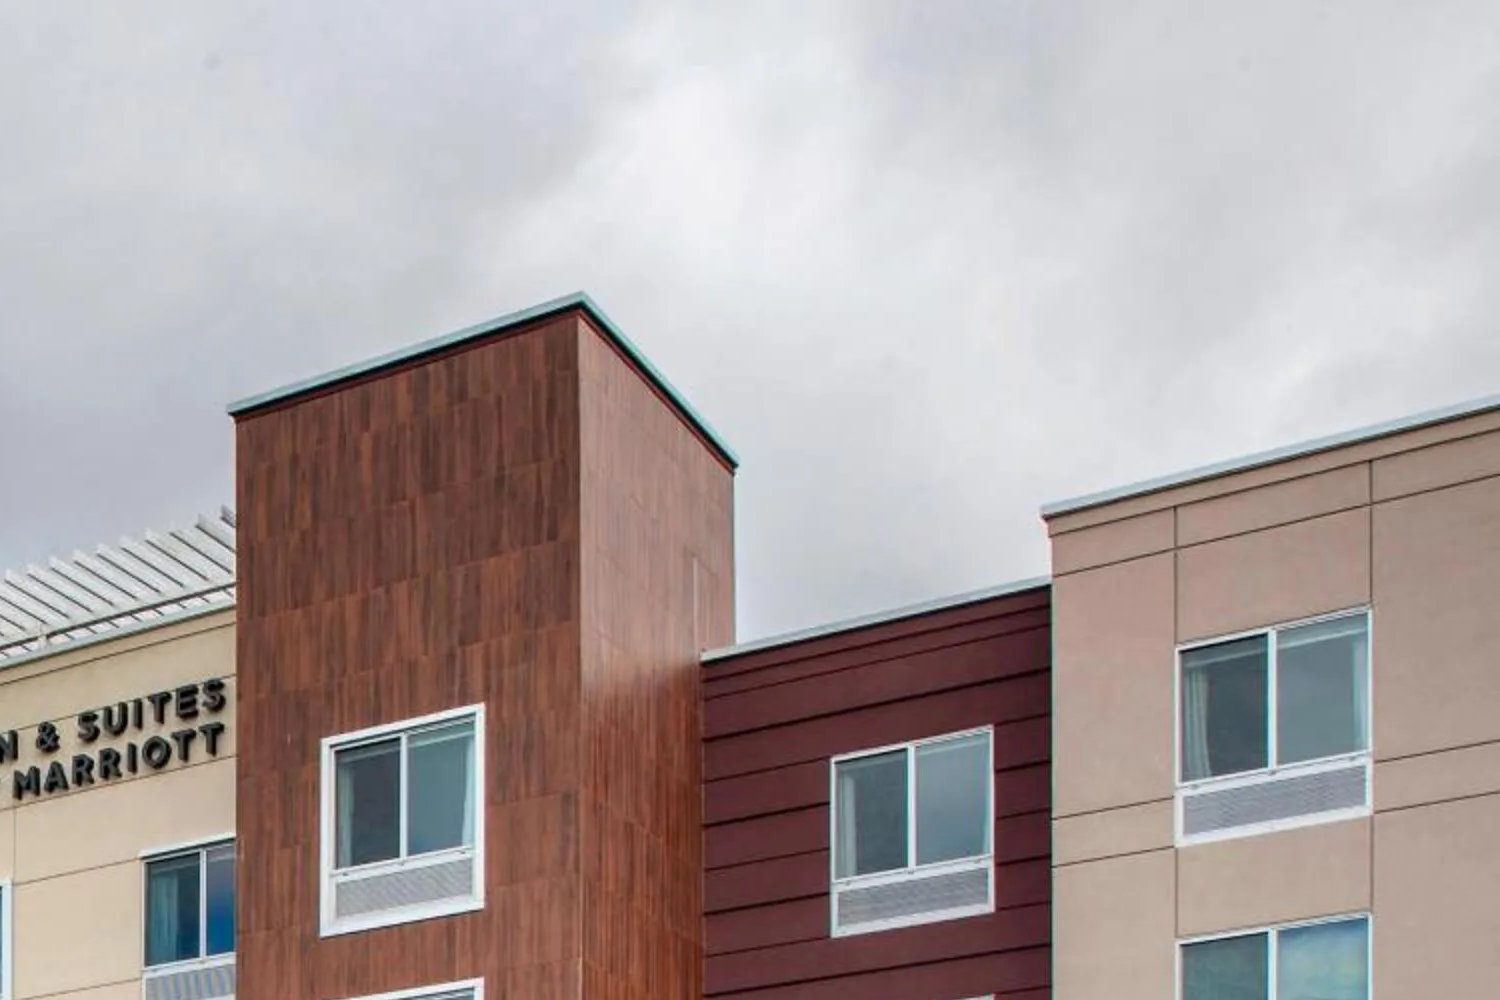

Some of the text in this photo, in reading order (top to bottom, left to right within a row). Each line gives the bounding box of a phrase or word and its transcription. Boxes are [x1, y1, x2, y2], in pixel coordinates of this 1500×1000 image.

[35, 721, 60, 752] &
[77, 679, 227, 743] SUITES
[13, 722, 225, 800] MARRIOTT
